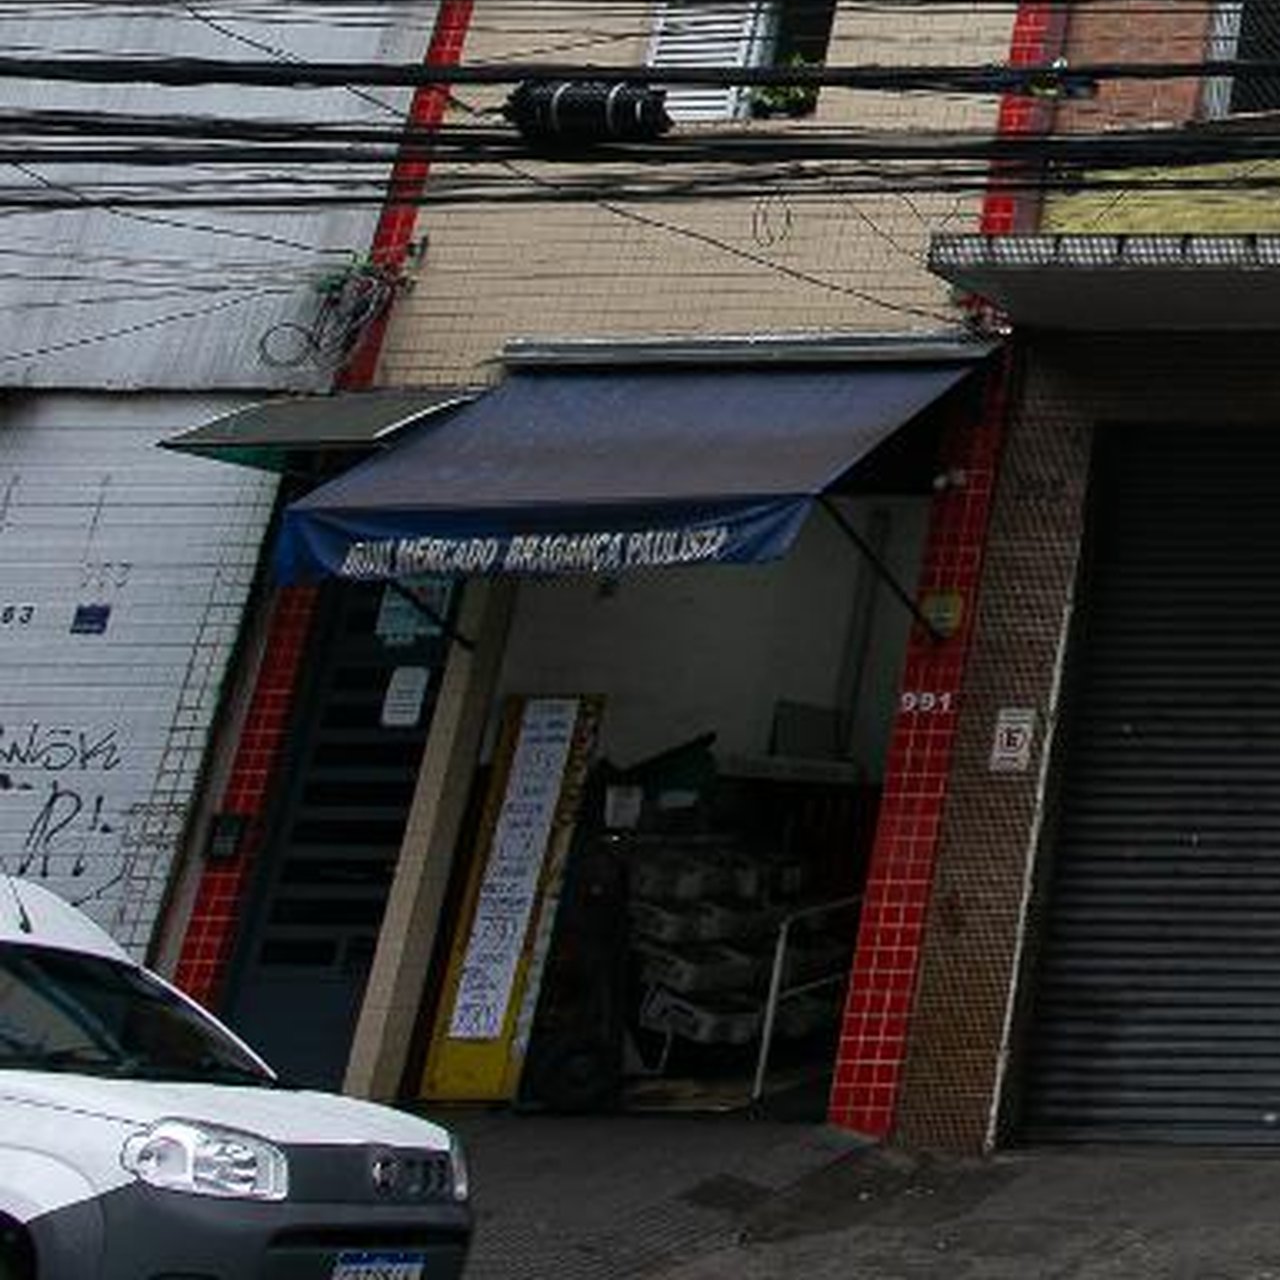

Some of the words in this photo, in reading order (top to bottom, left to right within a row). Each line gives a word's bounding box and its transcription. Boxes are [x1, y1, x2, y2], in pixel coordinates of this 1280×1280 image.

[397, 535, 499, 573] MERCADO
[503, 530, 624, 573] BRAGANÇA
[625, 525, 728, 566] PAULISTA
[901, 692, 952, 712] 991
